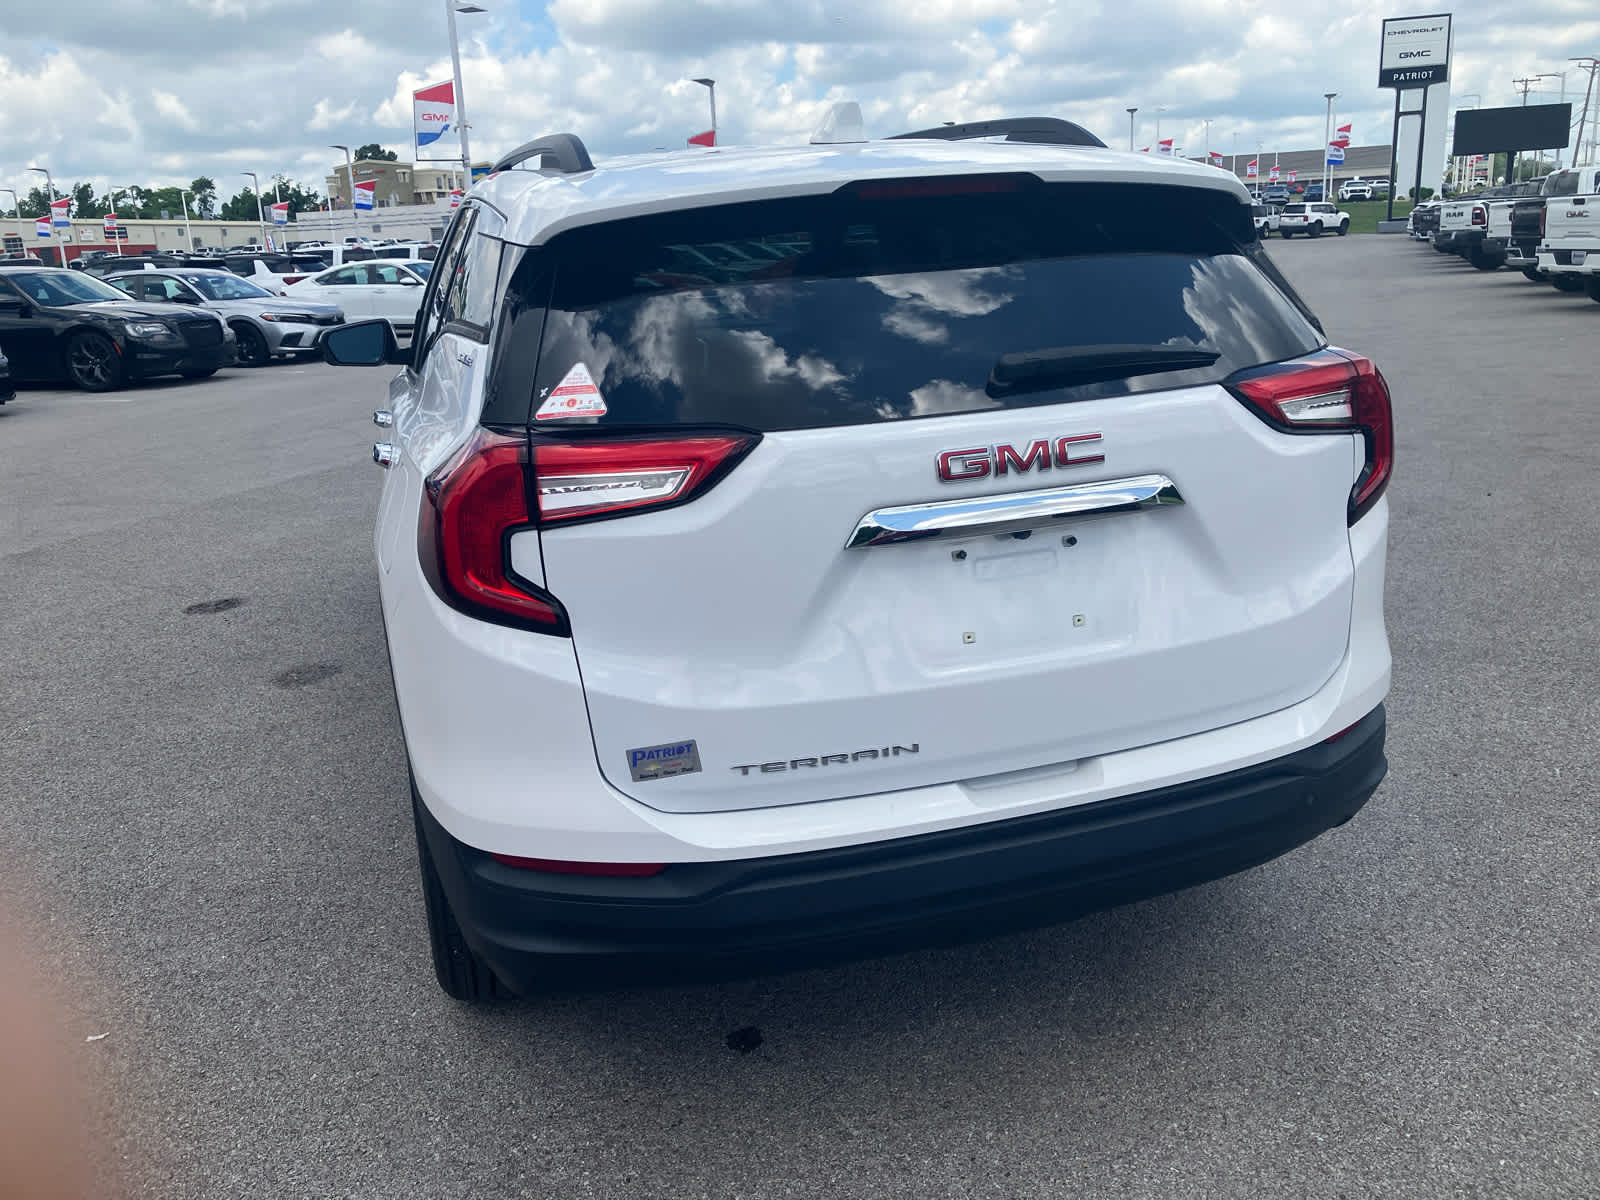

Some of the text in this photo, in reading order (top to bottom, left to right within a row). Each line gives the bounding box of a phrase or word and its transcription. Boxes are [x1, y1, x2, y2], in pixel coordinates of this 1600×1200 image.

[1387, 26, 1443, 36] CHEVROLET
[1399, 50, 1431, 59] GMC
[1393, 70, 1433, 81] PATRIOT
[1566, 210, 1590, 218] GMC
[936, 431, 1105, 483] GMC
[632, 743, 693, 768] PATRIOT
[730, 743, 920, 776] TERRAIN
